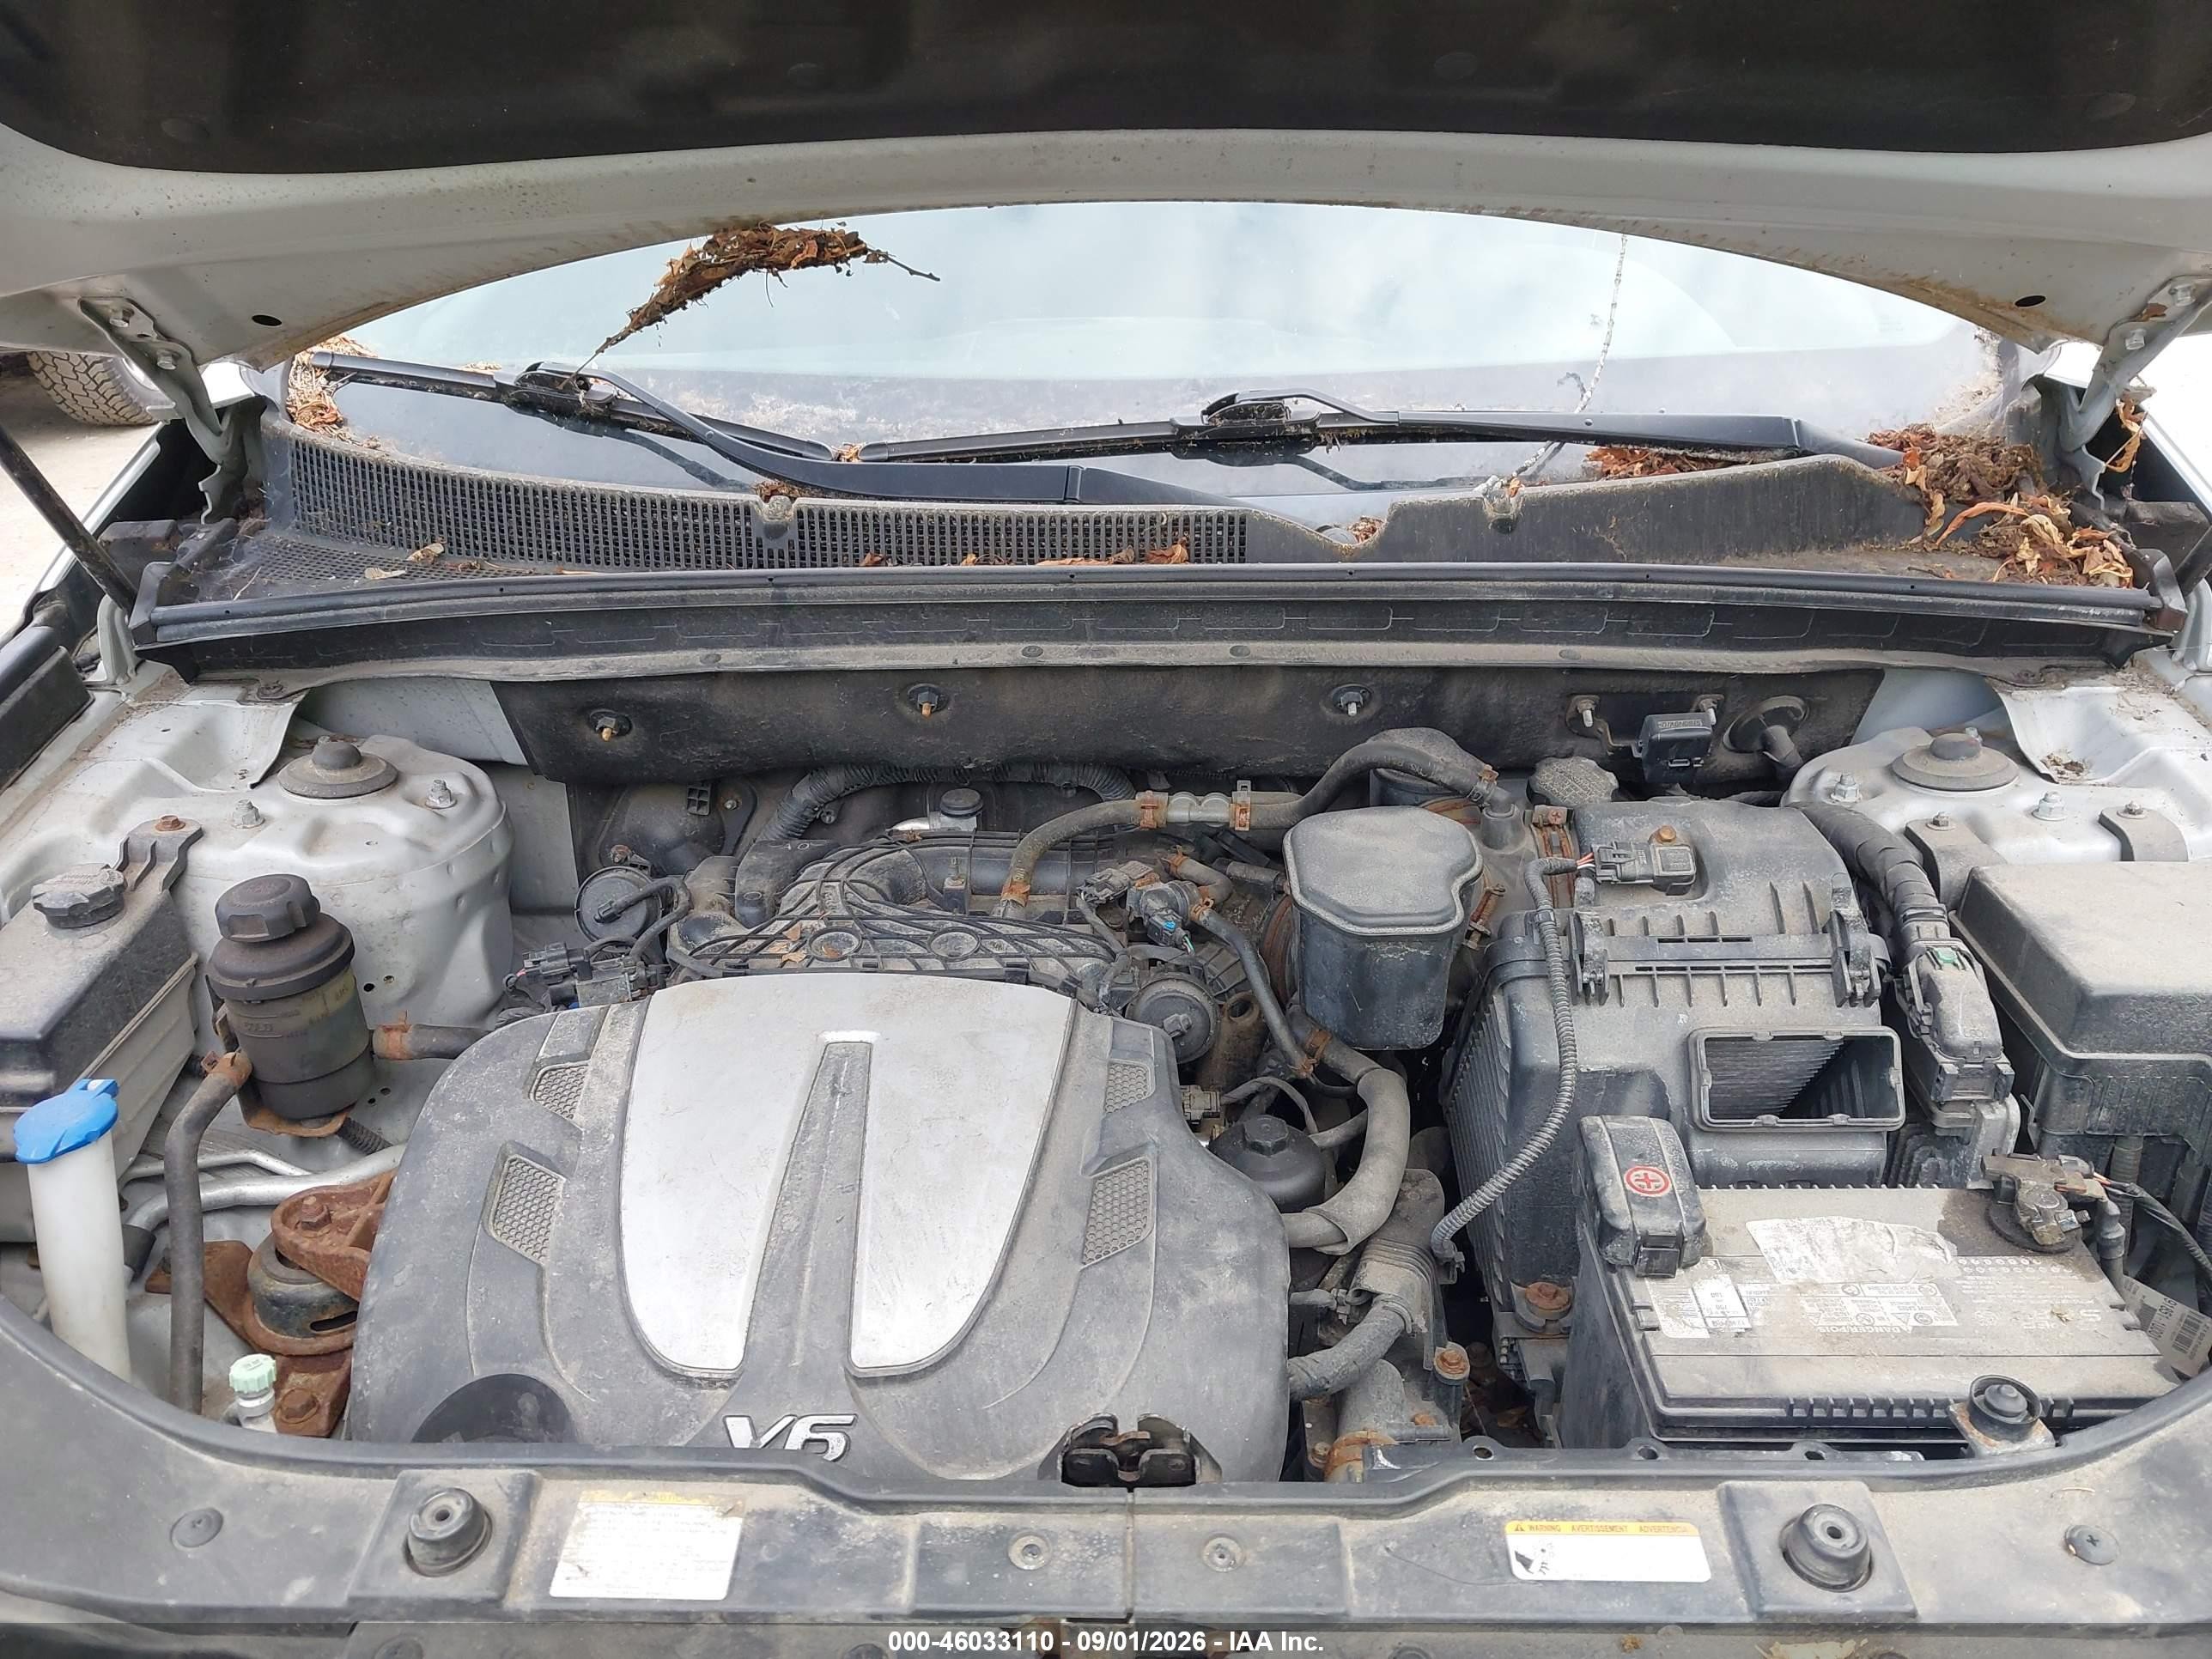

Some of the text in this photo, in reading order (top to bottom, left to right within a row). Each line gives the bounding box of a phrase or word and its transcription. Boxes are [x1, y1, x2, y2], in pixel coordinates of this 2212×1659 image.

[723, 1414, 857, 1462] V6
[1528, 1523, 1561, 1533] WARNING
[1571, 1524, 1628, 1533] AVERTISSEMENT
